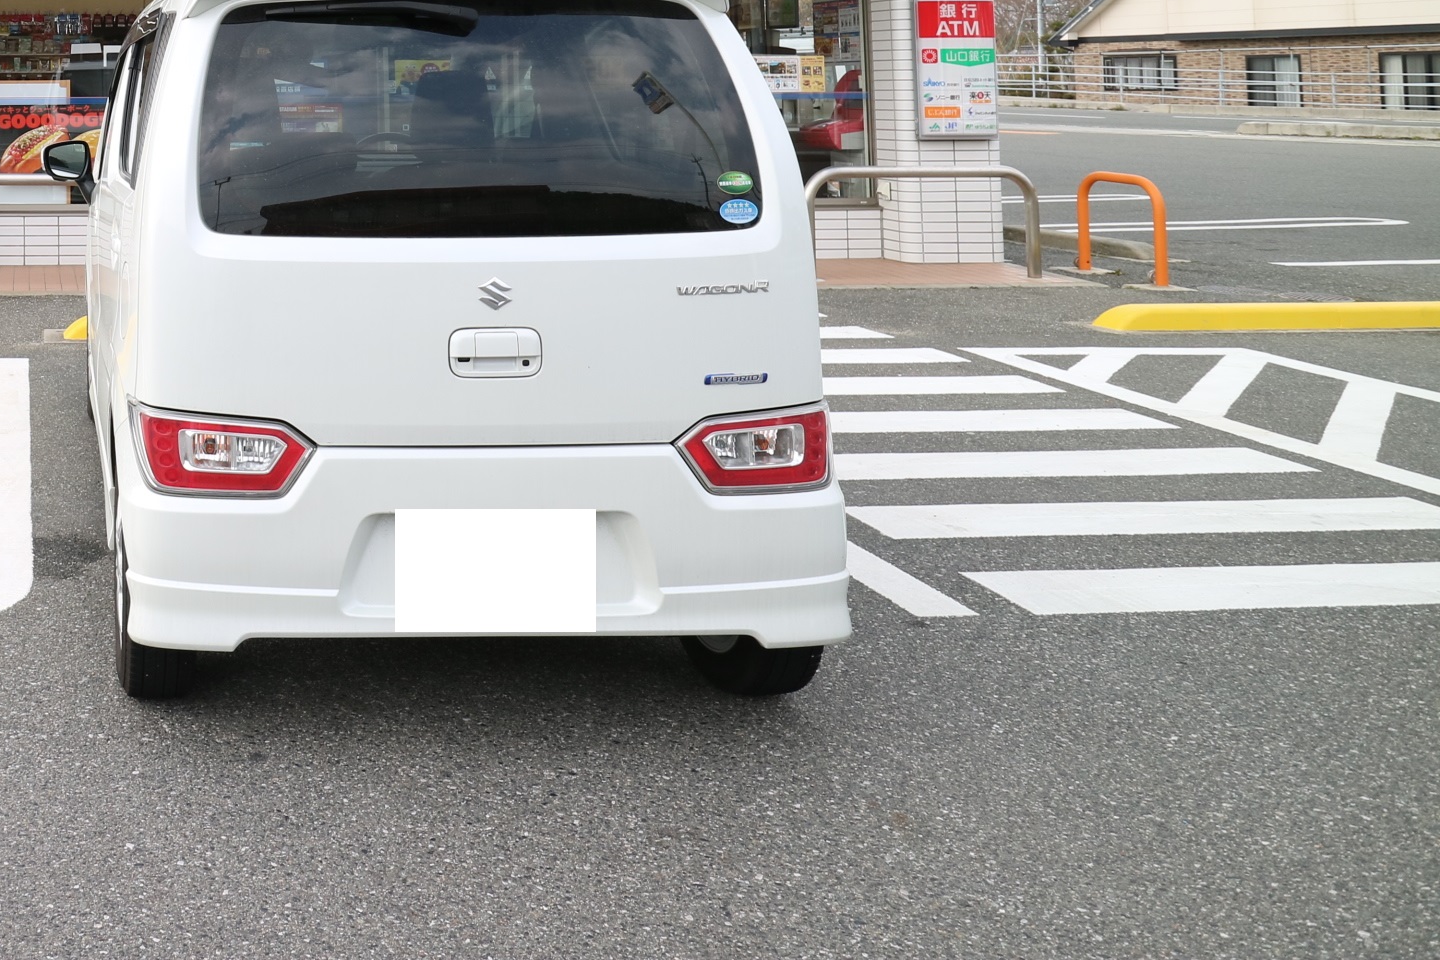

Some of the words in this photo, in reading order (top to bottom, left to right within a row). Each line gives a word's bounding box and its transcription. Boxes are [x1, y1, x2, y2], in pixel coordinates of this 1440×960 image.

[939, 3, 977, 19] 銀行
[936, 20, 980, 36] ATM
[946, 50, 990, 62] 山口銀行
